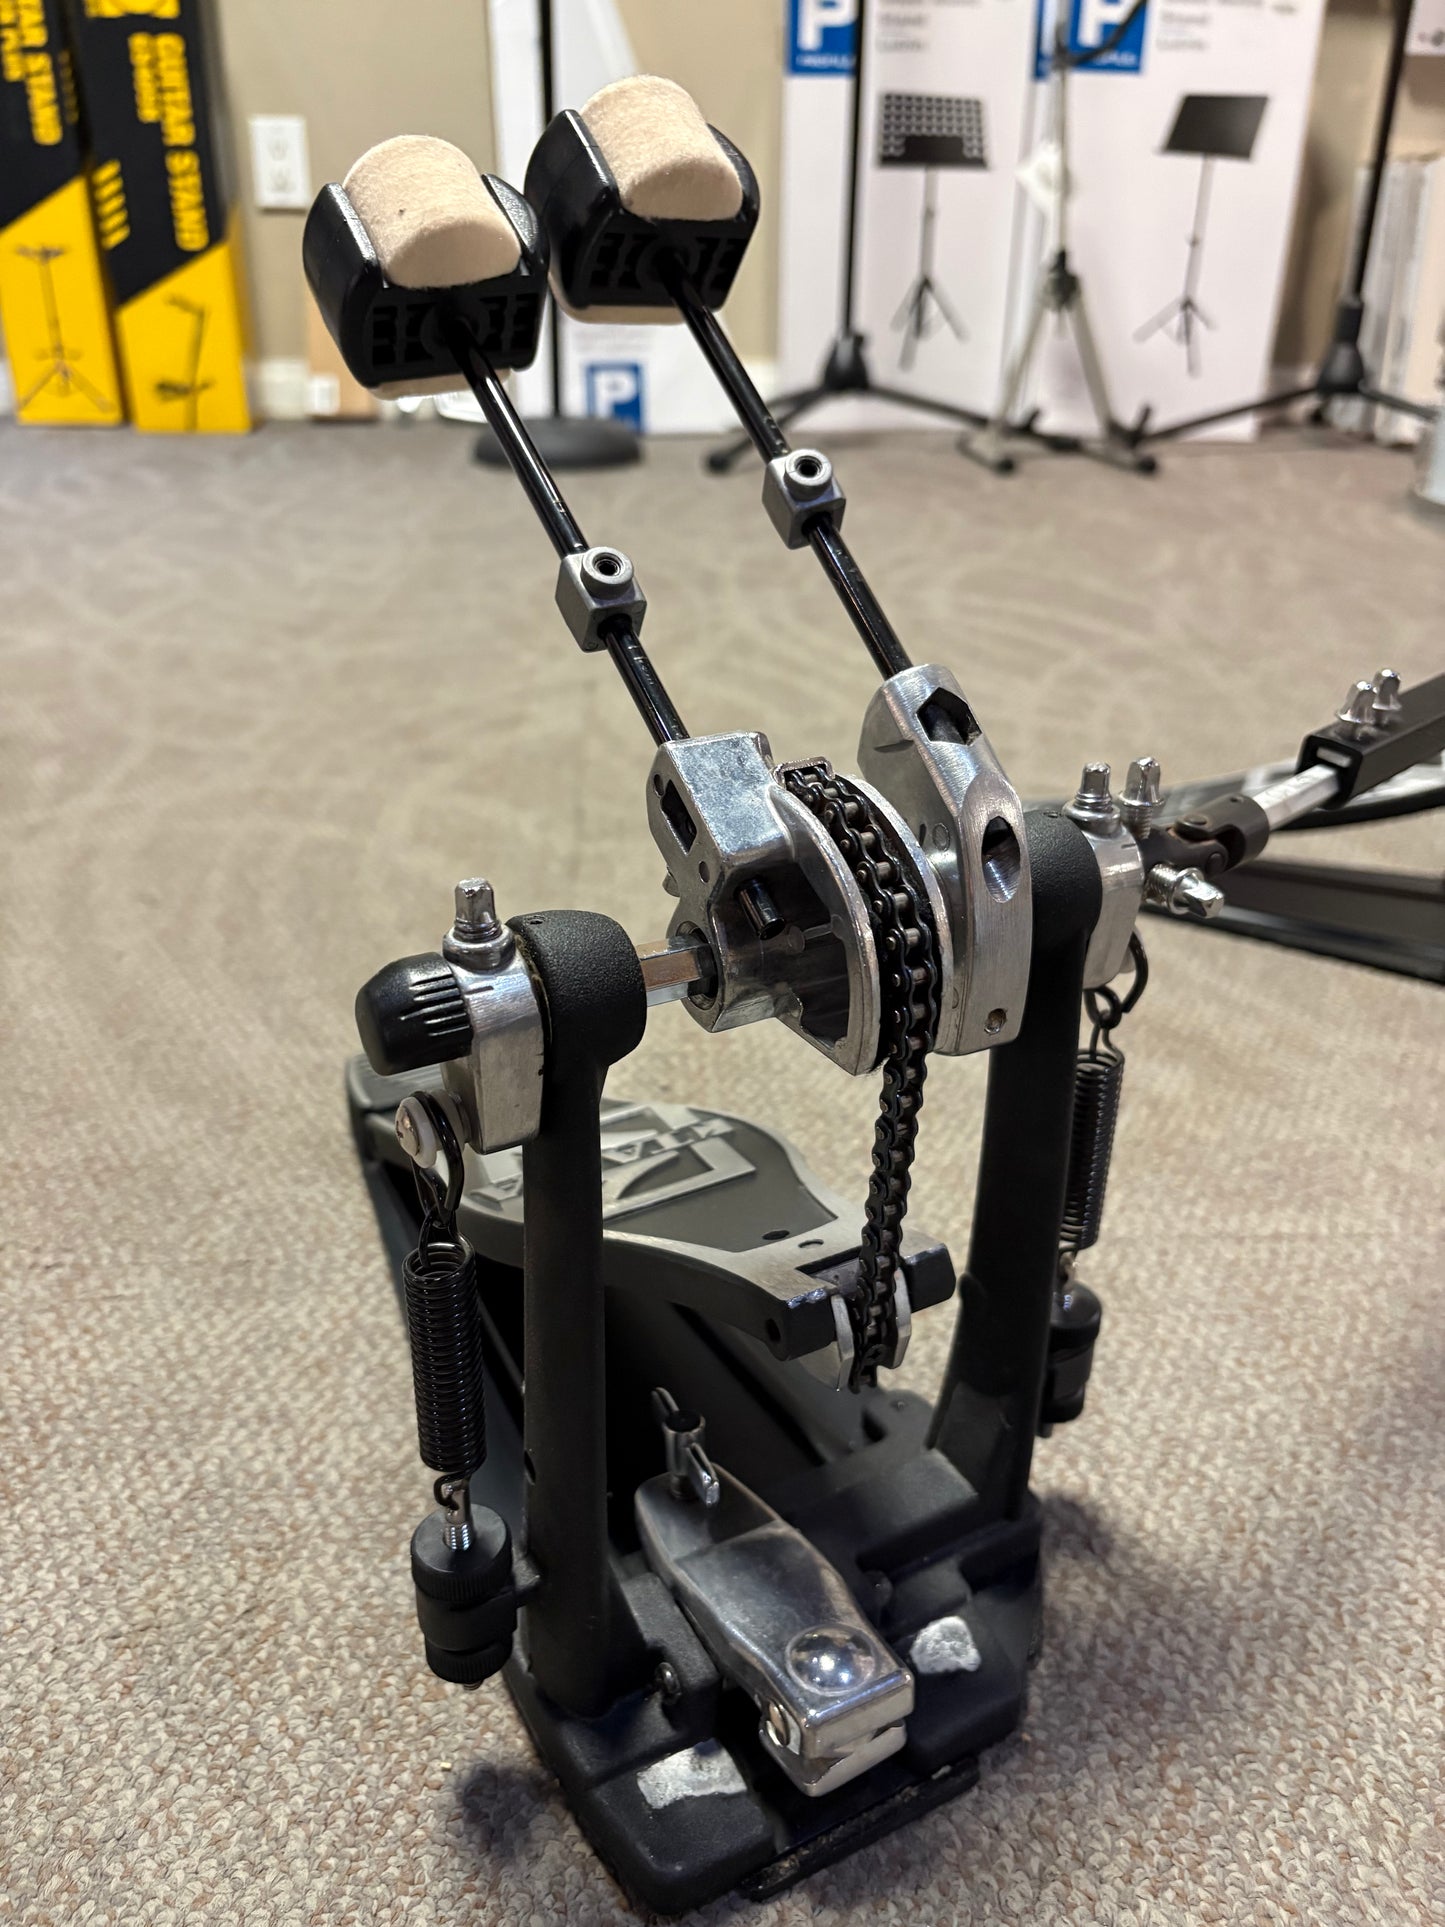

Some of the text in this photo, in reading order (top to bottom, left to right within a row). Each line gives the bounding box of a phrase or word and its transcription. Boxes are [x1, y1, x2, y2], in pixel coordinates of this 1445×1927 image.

[25, 52, 63, 145] STAND
[156, 32, 209, 252] GUITAR STAND
[595, 371, 639, 418] P
